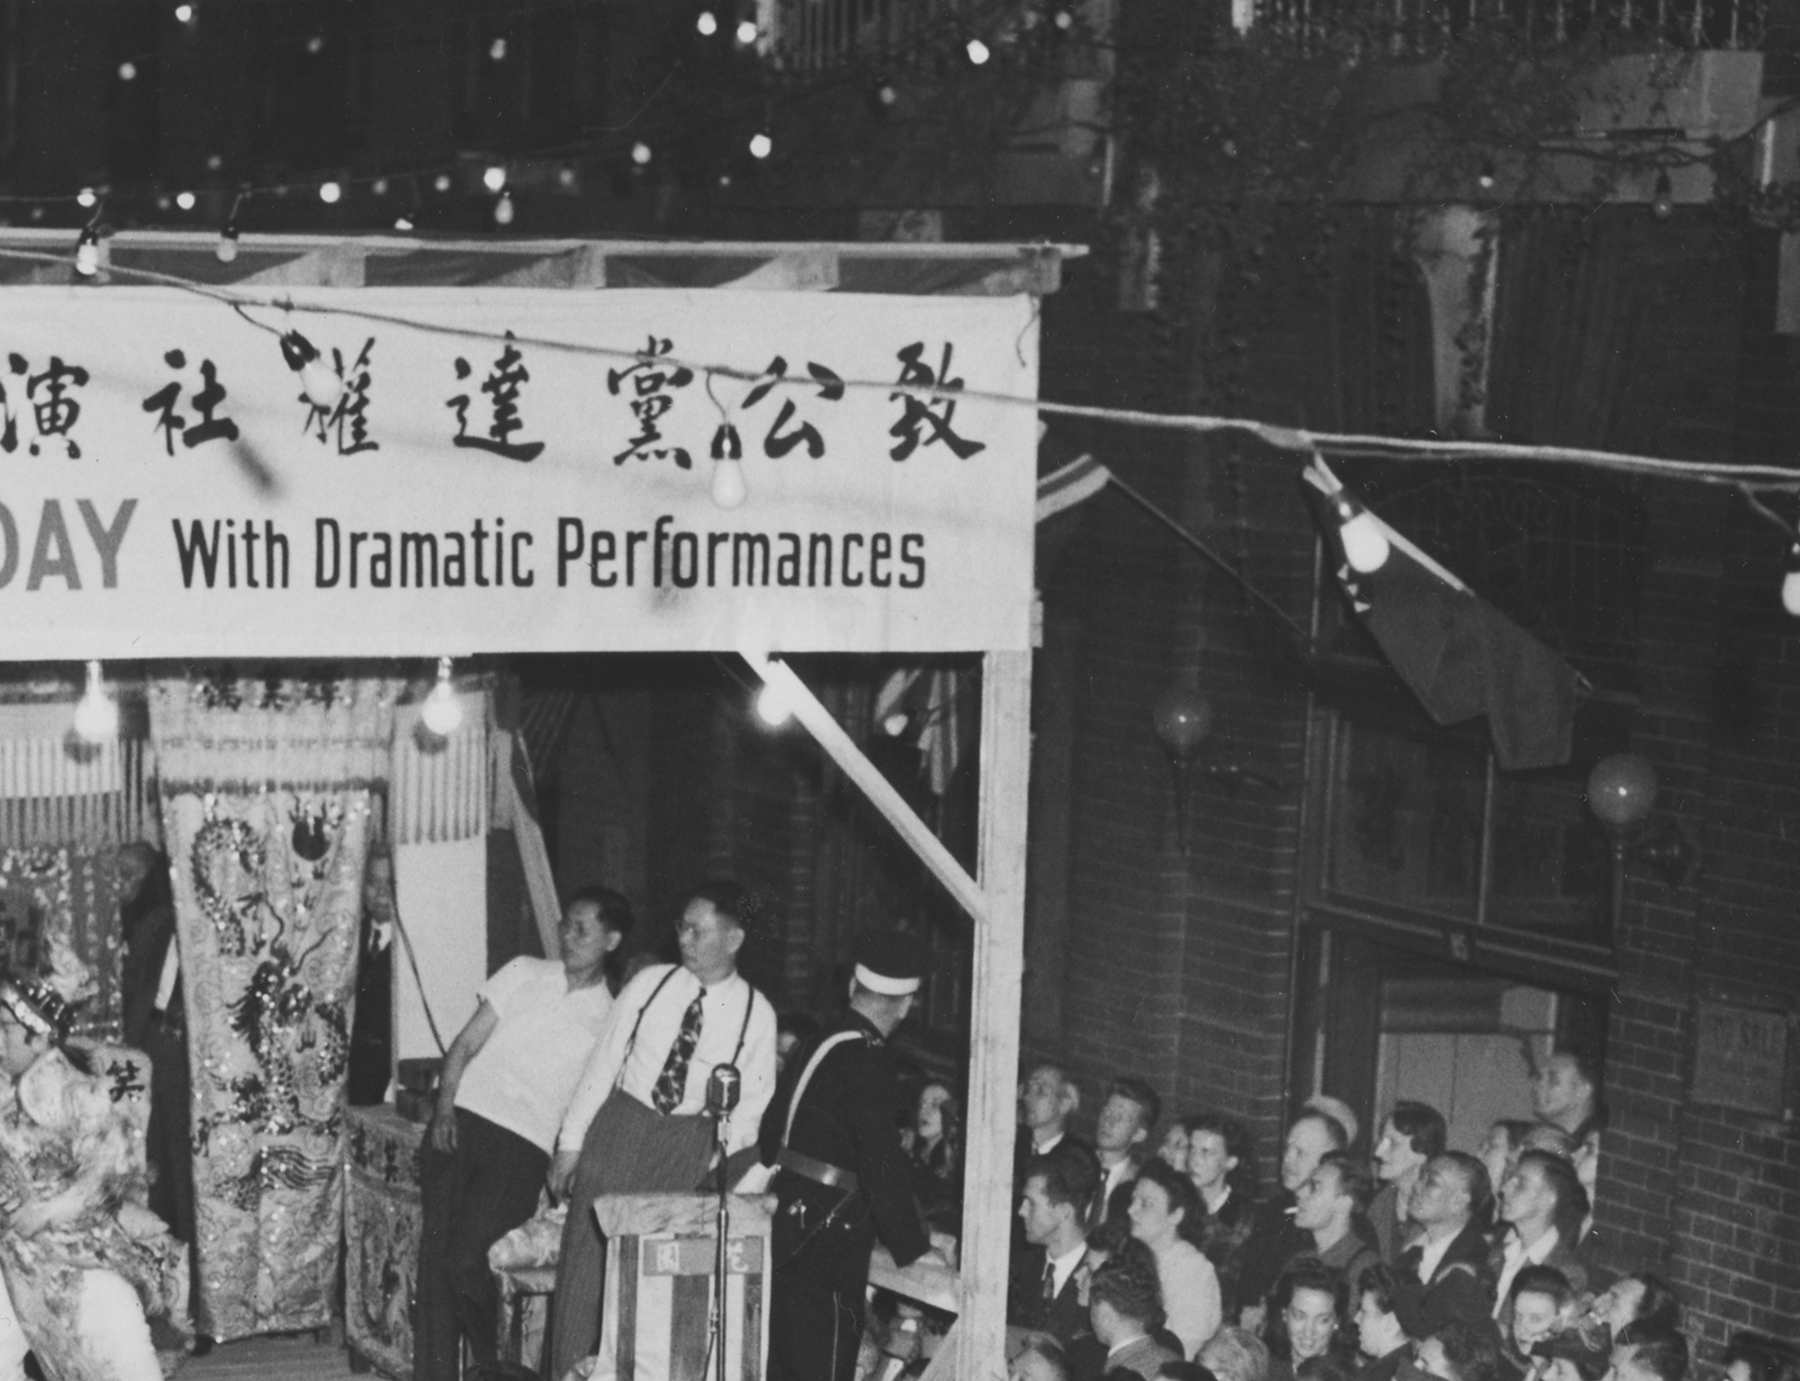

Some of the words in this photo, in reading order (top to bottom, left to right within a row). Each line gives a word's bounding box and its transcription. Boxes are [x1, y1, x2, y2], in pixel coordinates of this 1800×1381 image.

[171, 518, 292, 589] With
[314, 517, 535, 589] Dramatic
[556, 515, 926, 591] Performances
